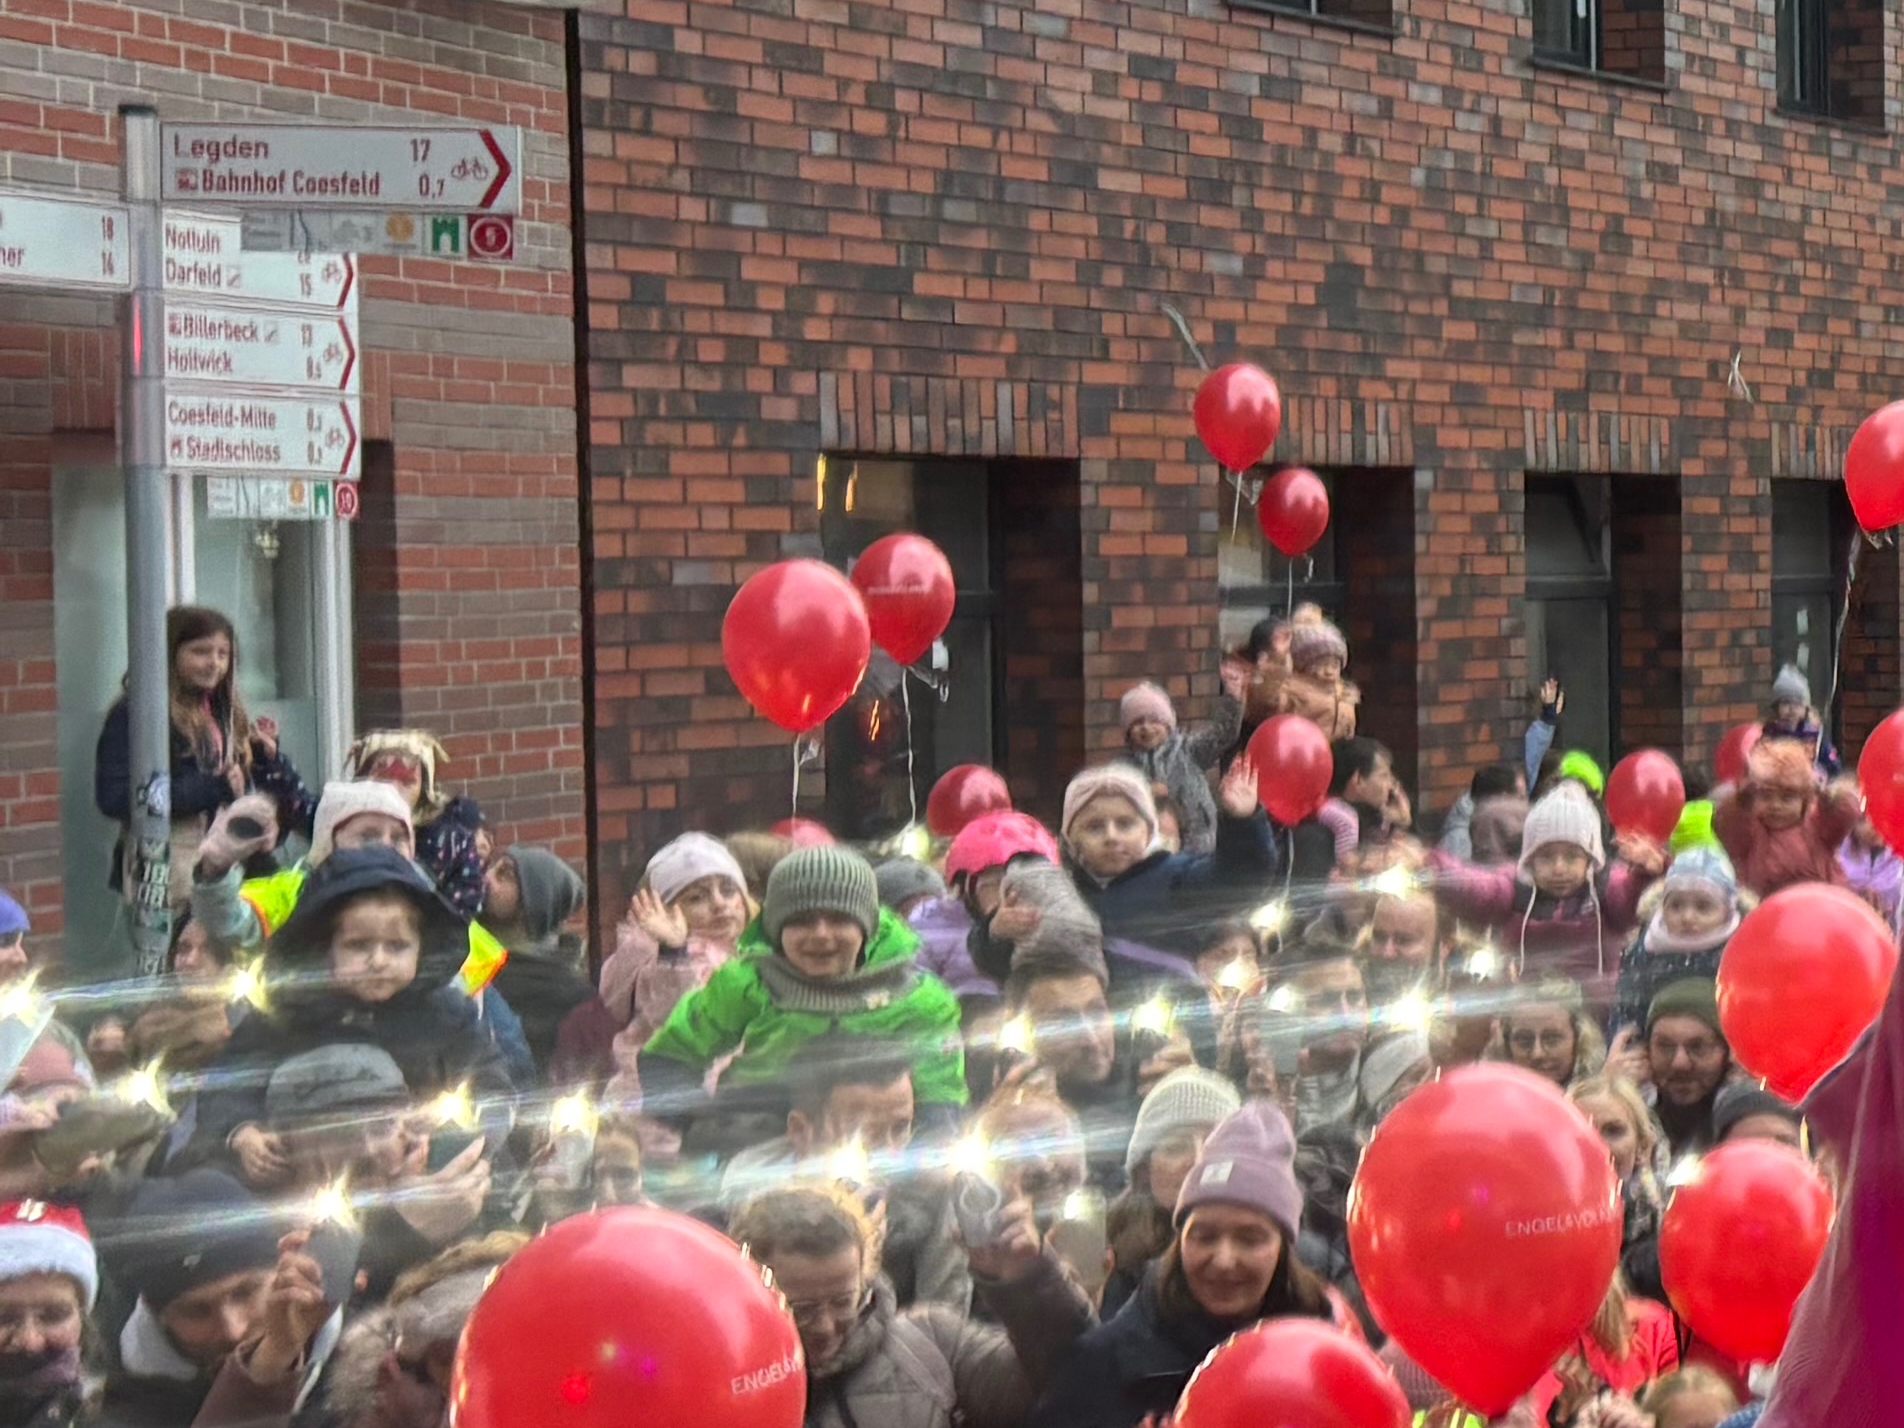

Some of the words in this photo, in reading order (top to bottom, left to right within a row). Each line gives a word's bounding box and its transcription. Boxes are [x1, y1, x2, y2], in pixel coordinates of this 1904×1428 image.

[174, 133, 269, 162] Legden
[410, 138, 430, 163] 17
[203, 168, 286, 195] Bahnhof
[293, 170, 381, 197] Coesfeld
[165, 257, 221, 288] Darfeld
[184, 313, 259, 343] Billerbeck
[168, 347, 233, 373] Holtwick
[168, 401, 277, 430] Coesfeld-Mitte
[186, 435, 281, 462] Stadtschloss
